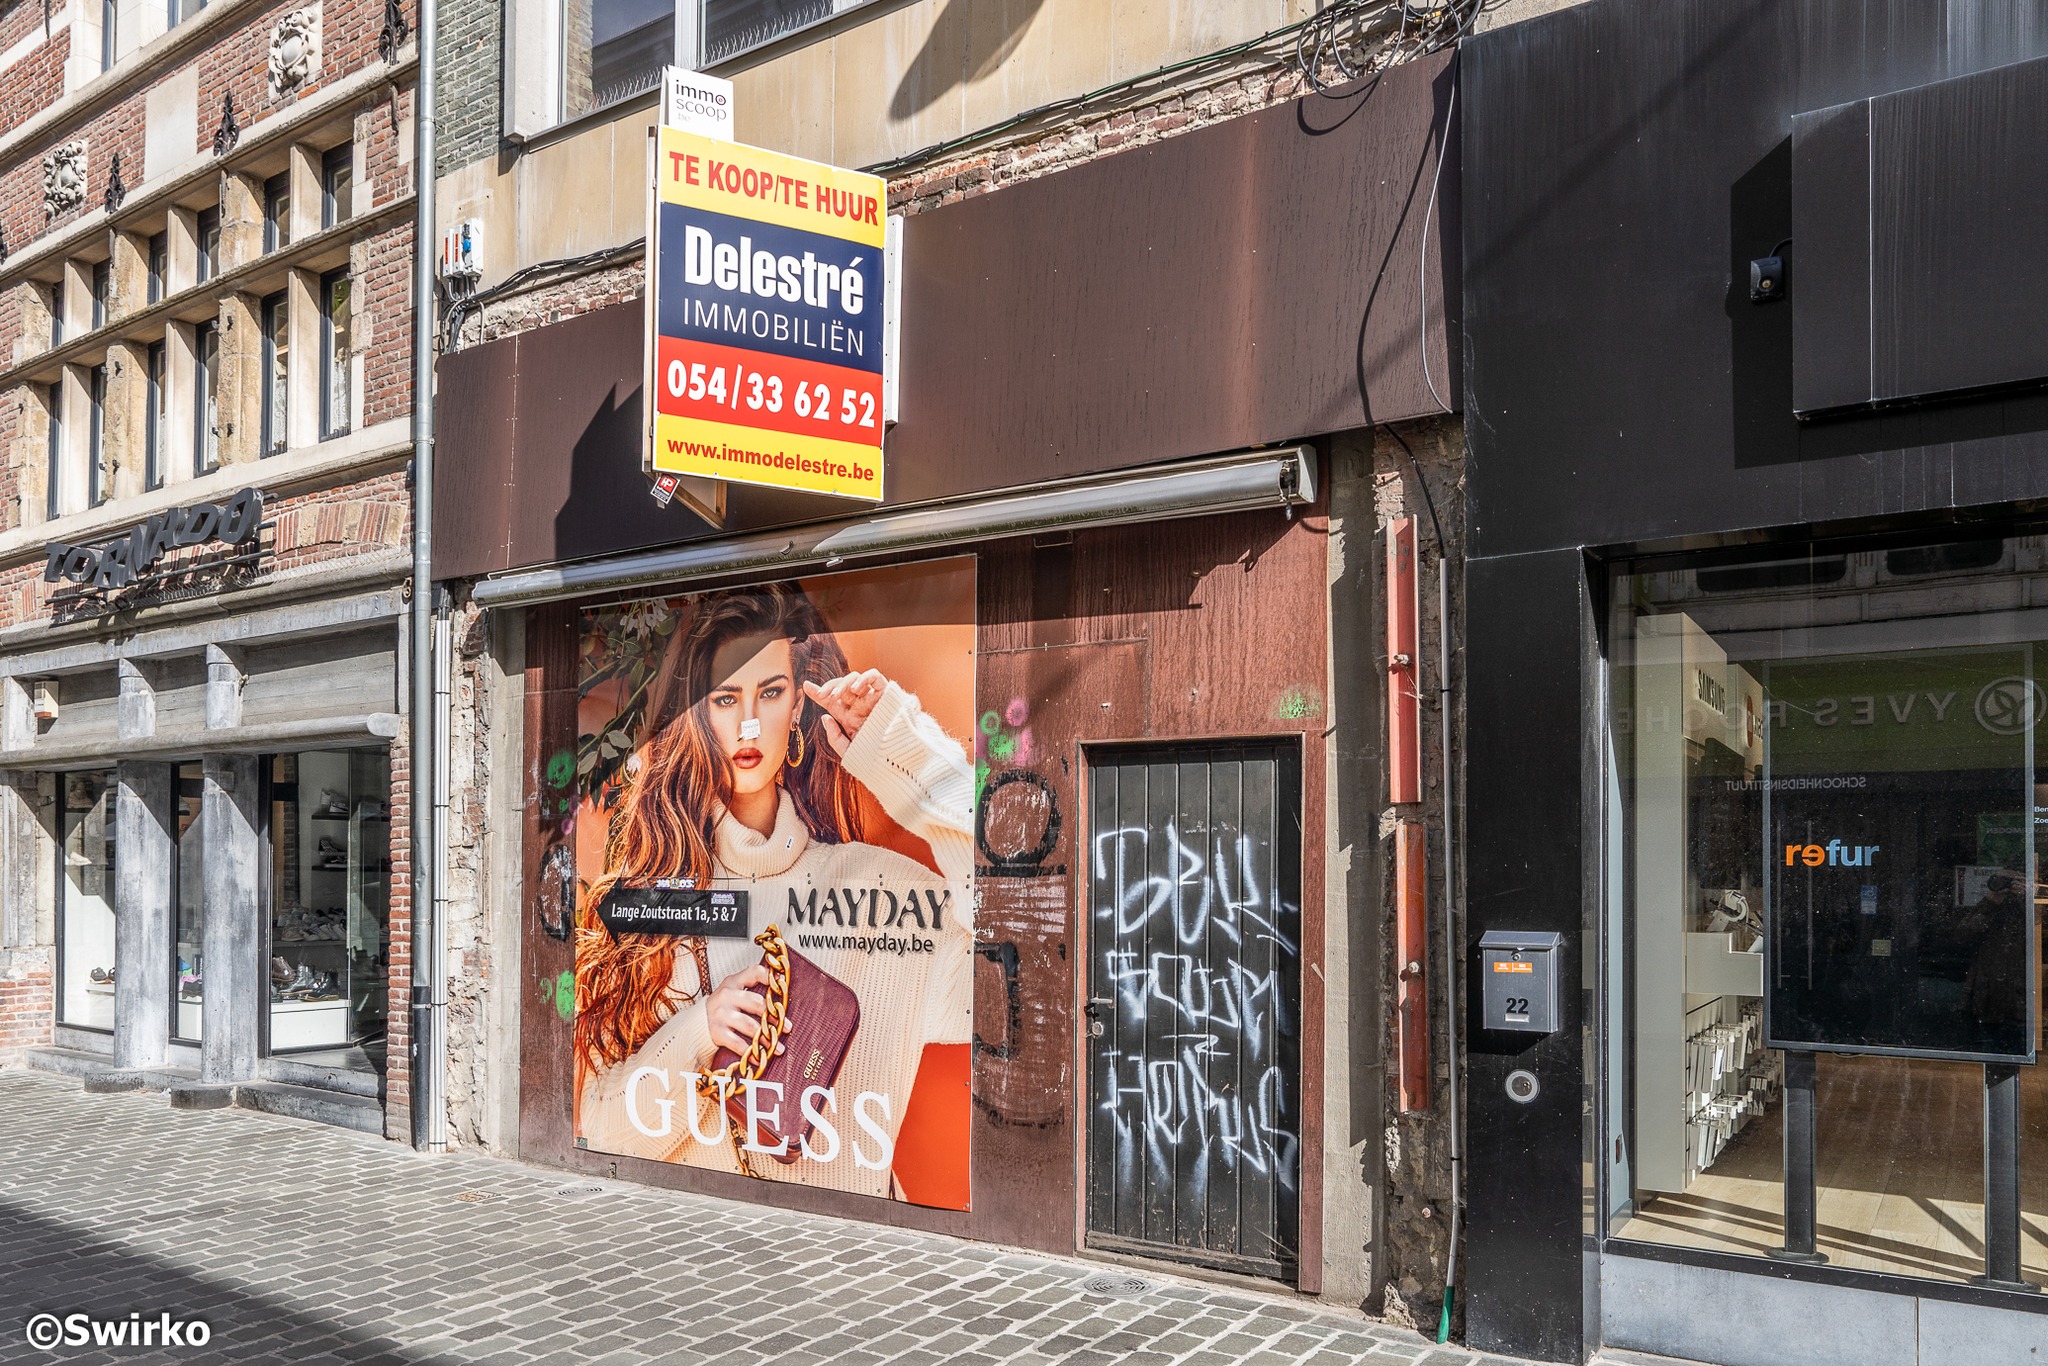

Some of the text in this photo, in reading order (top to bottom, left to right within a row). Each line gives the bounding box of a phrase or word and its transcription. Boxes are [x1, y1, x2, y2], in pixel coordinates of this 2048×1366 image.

[676, 98, 727, 122] scoop
[669, 151, 878, 226] TE KOOP/TE HUUR
[684, 224, 864, 315] Delestré
[683, 298, 864, 356] IMMOBILIËN
[667, 359, 876, 428] 054/33 62 52
[667, 439, 875, 481] www.immodelestre.be
[44, 487, 263, 589] TORNADO
[611, 903, 738, 923] Lange Zoutstraat 1a, 5 & 7
[786, 887, 951, 930] MAYDAY
[798, 933, 934, 956] www.mayday.be
[1506, 997, 1529, 1014] 22
[803, 1048, 820, 1079] GUESS
[624, 1065, 894, 1171] GUESS
